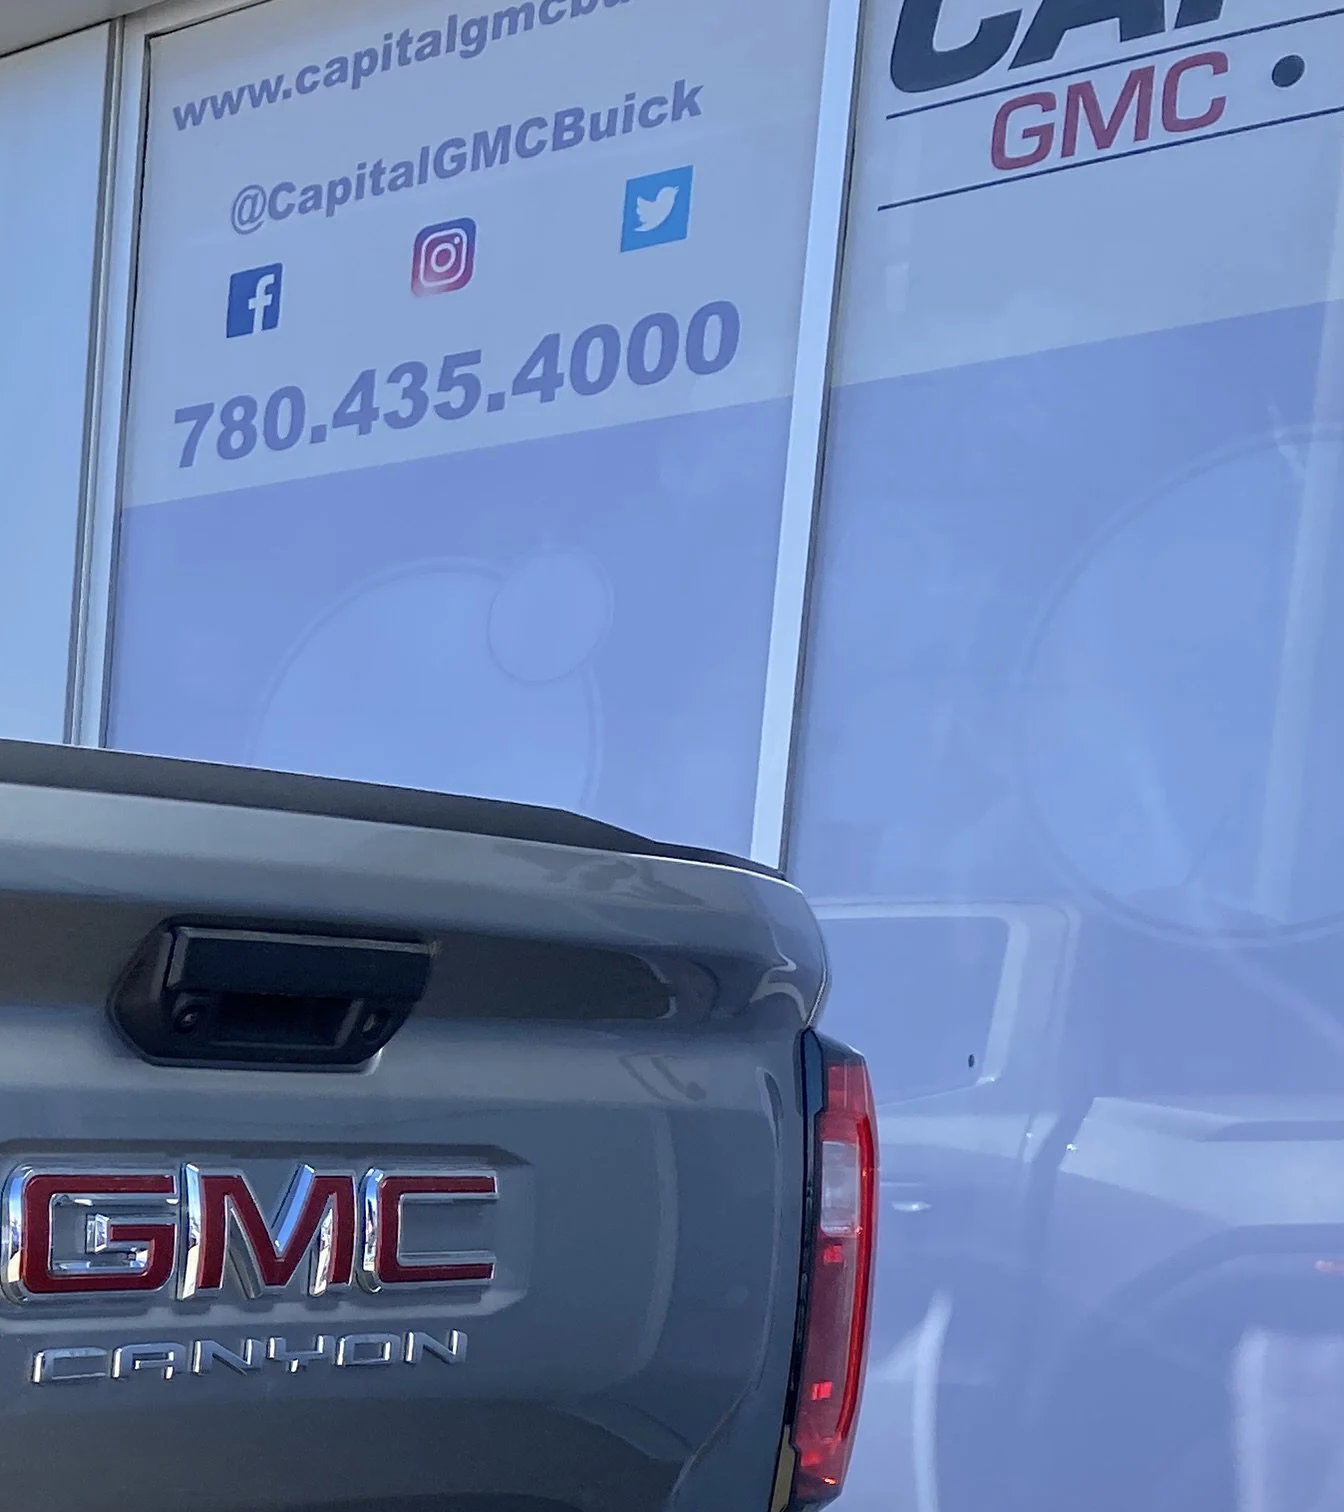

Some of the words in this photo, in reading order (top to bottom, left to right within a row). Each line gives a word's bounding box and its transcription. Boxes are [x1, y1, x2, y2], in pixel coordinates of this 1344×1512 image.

[230, 79, 706, 236] @CapitalGMCBuick
[990, 51, 1230, 171] GMC
[172, 300, 742, 470] 780.435.4000
[0, 1162, 500, 1303] GMC
[30, 1329, 469, 1386] CANYON
